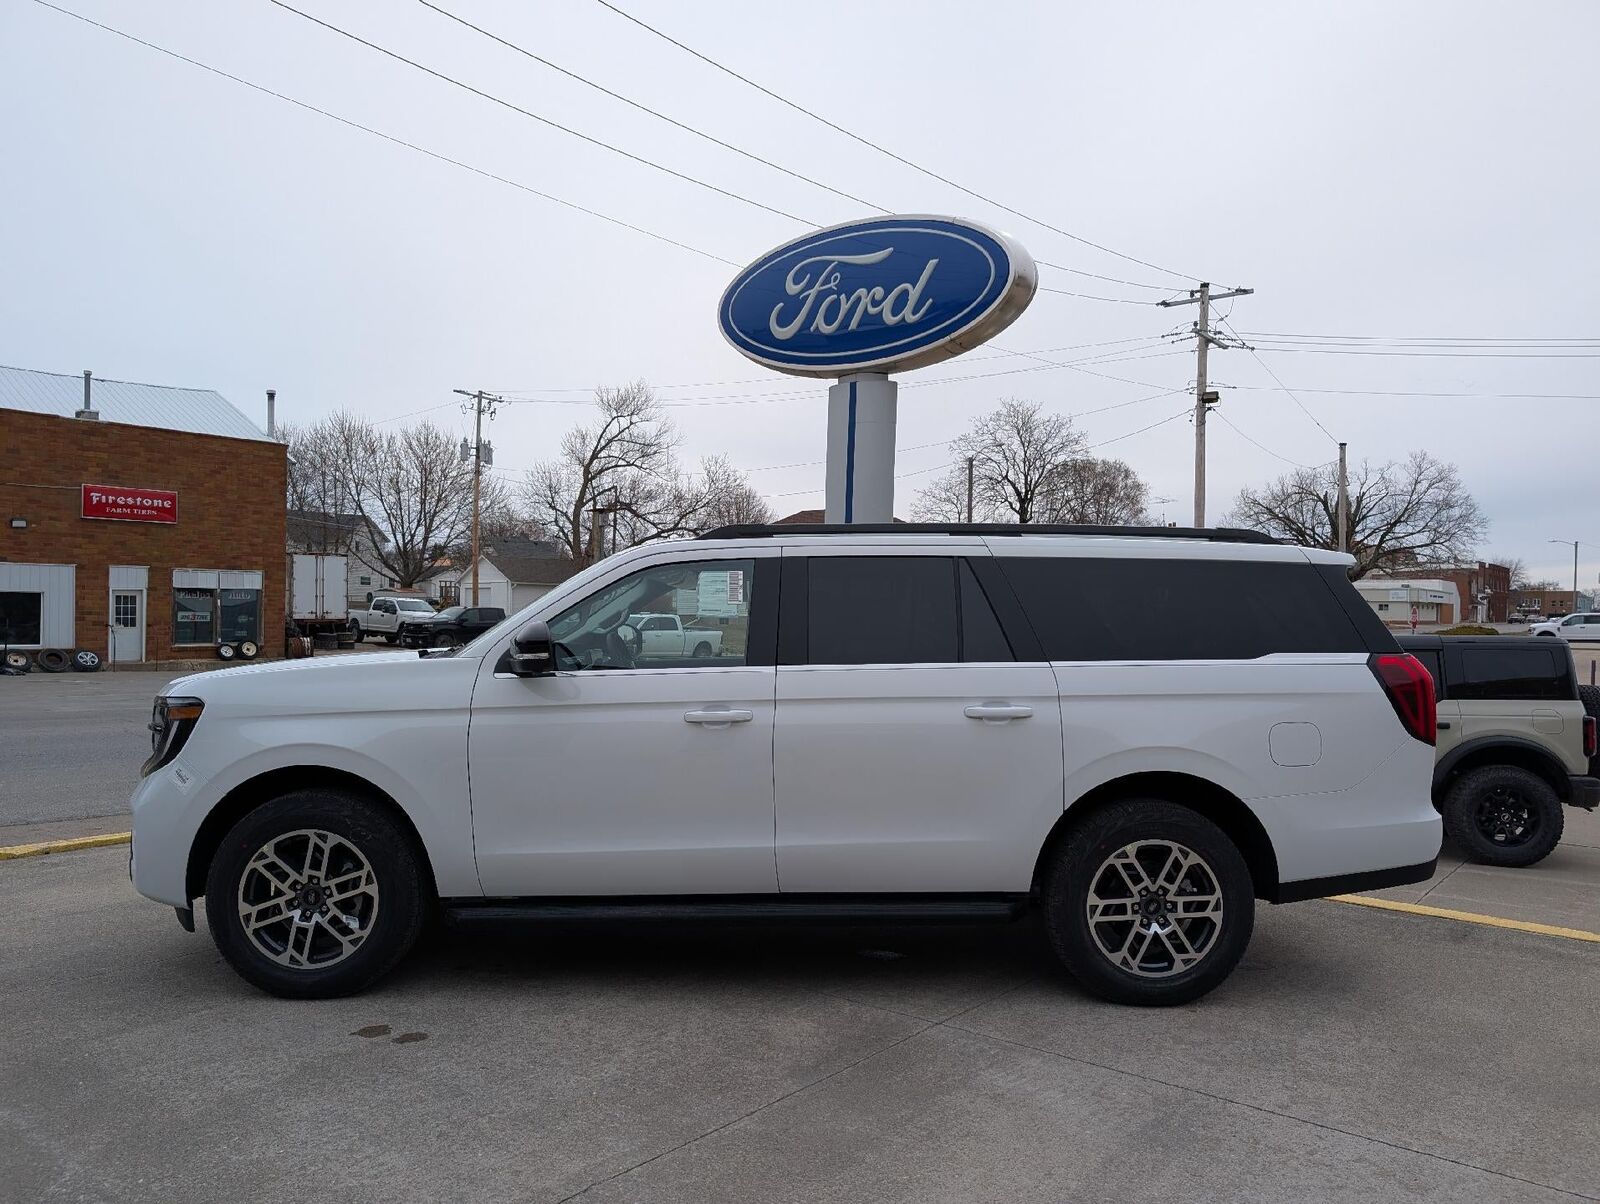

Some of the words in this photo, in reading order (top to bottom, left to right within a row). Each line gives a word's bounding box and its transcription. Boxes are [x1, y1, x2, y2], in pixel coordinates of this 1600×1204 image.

[769, 247, 939, 341] Ford
[90, 492, 173, 508] Firestone
[106, 506, 131, 514] FARM
[134, 508, 158, 516] TIRES
